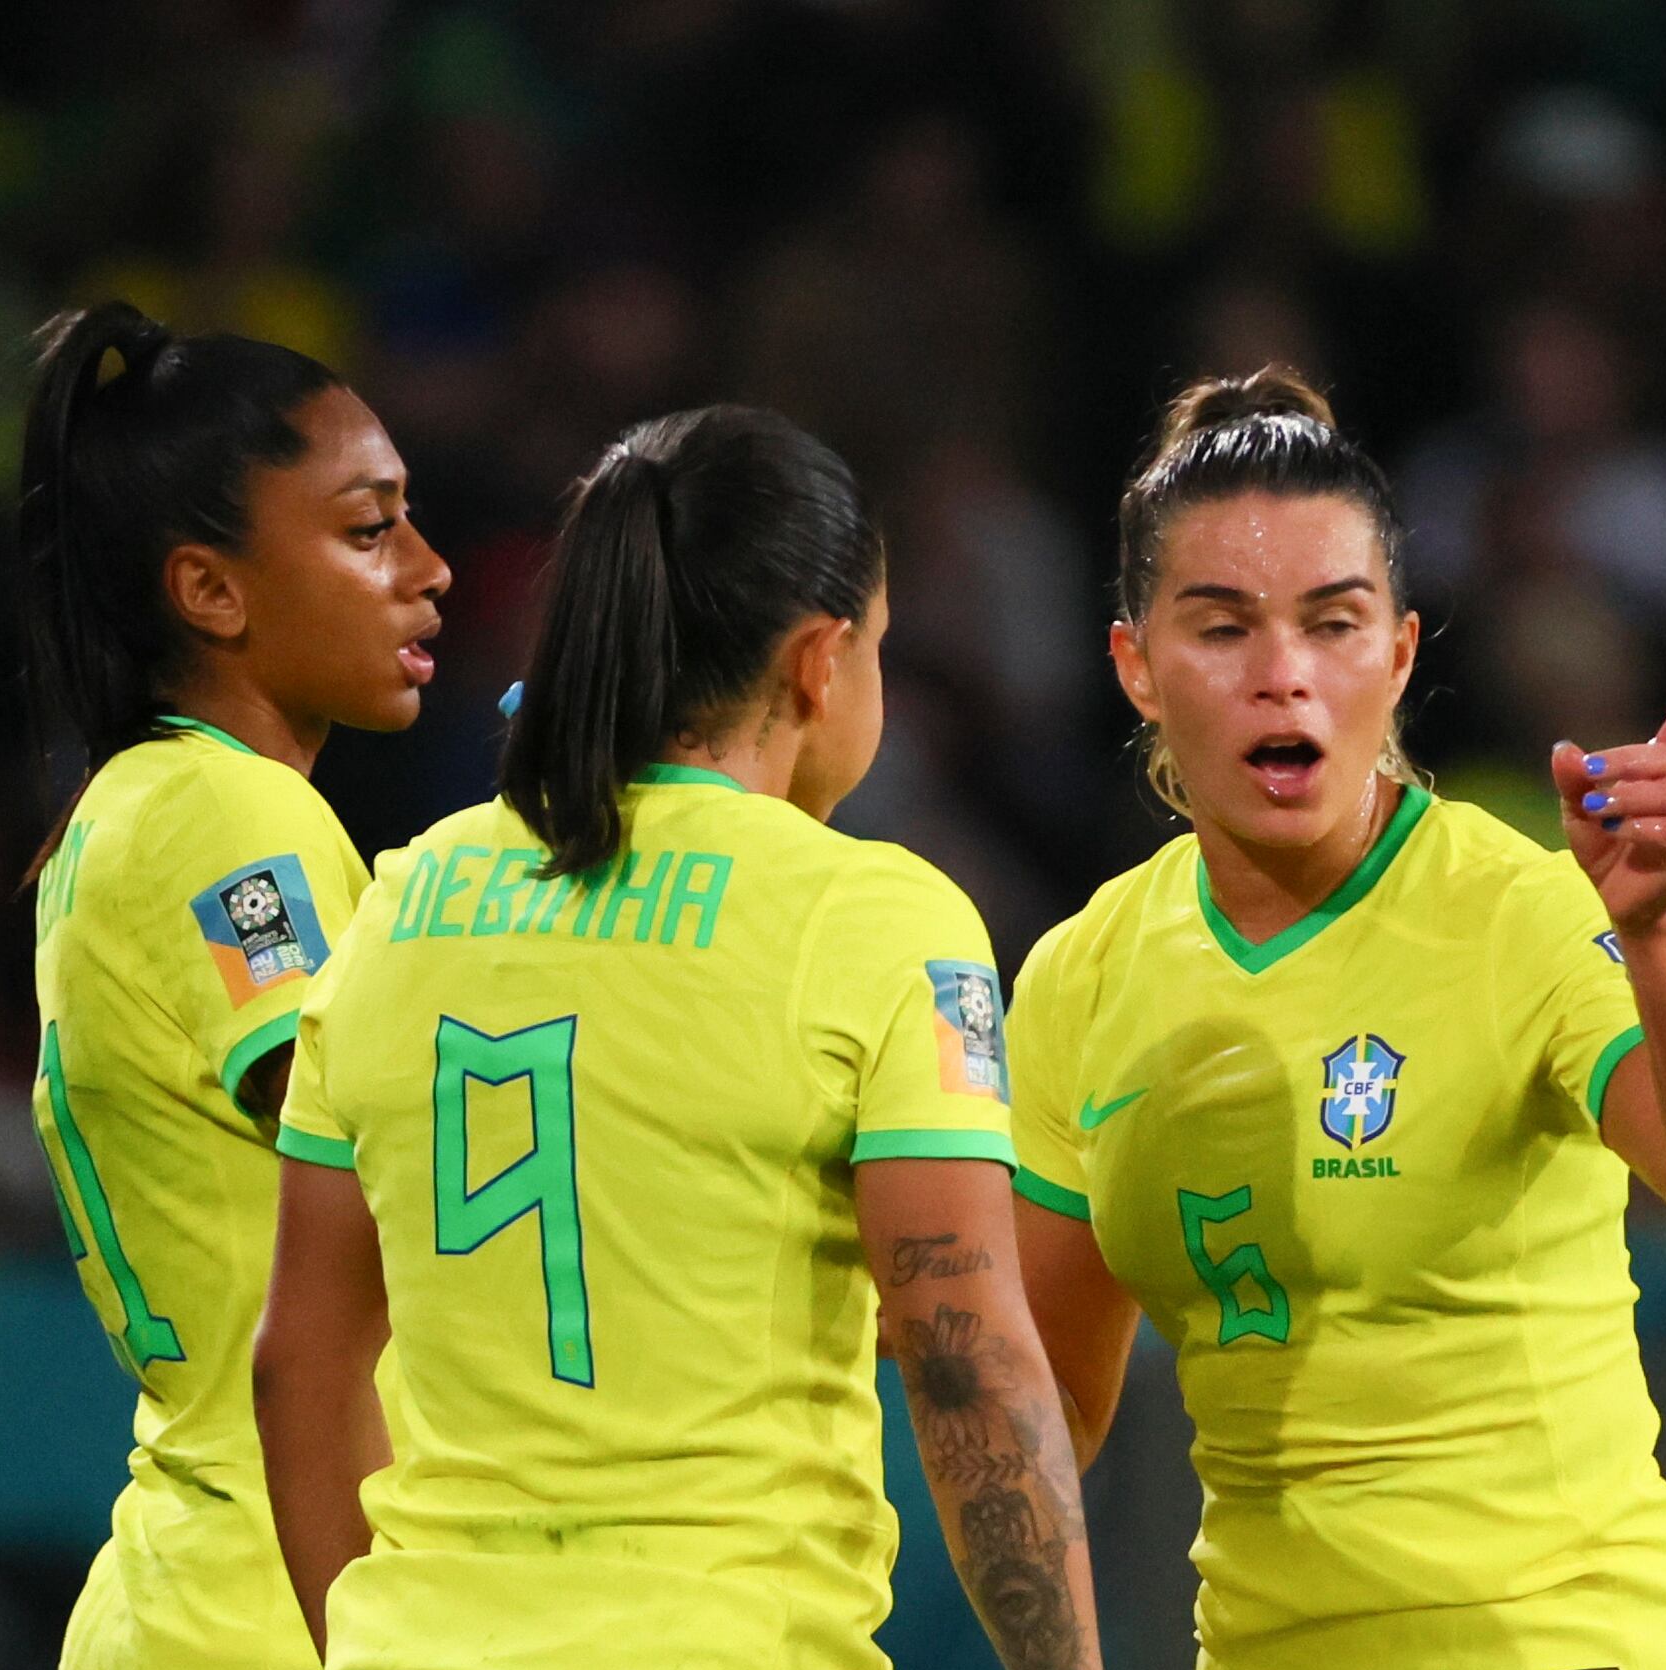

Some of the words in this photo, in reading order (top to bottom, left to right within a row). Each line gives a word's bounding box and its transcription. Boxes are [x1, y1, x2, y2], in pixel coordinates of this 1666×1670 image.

[1344, 1081, 1375, 1095] CBF
[1312, 1156, 1401, 1179] BRASIL
[434, 1014, 595, 1389] 9
